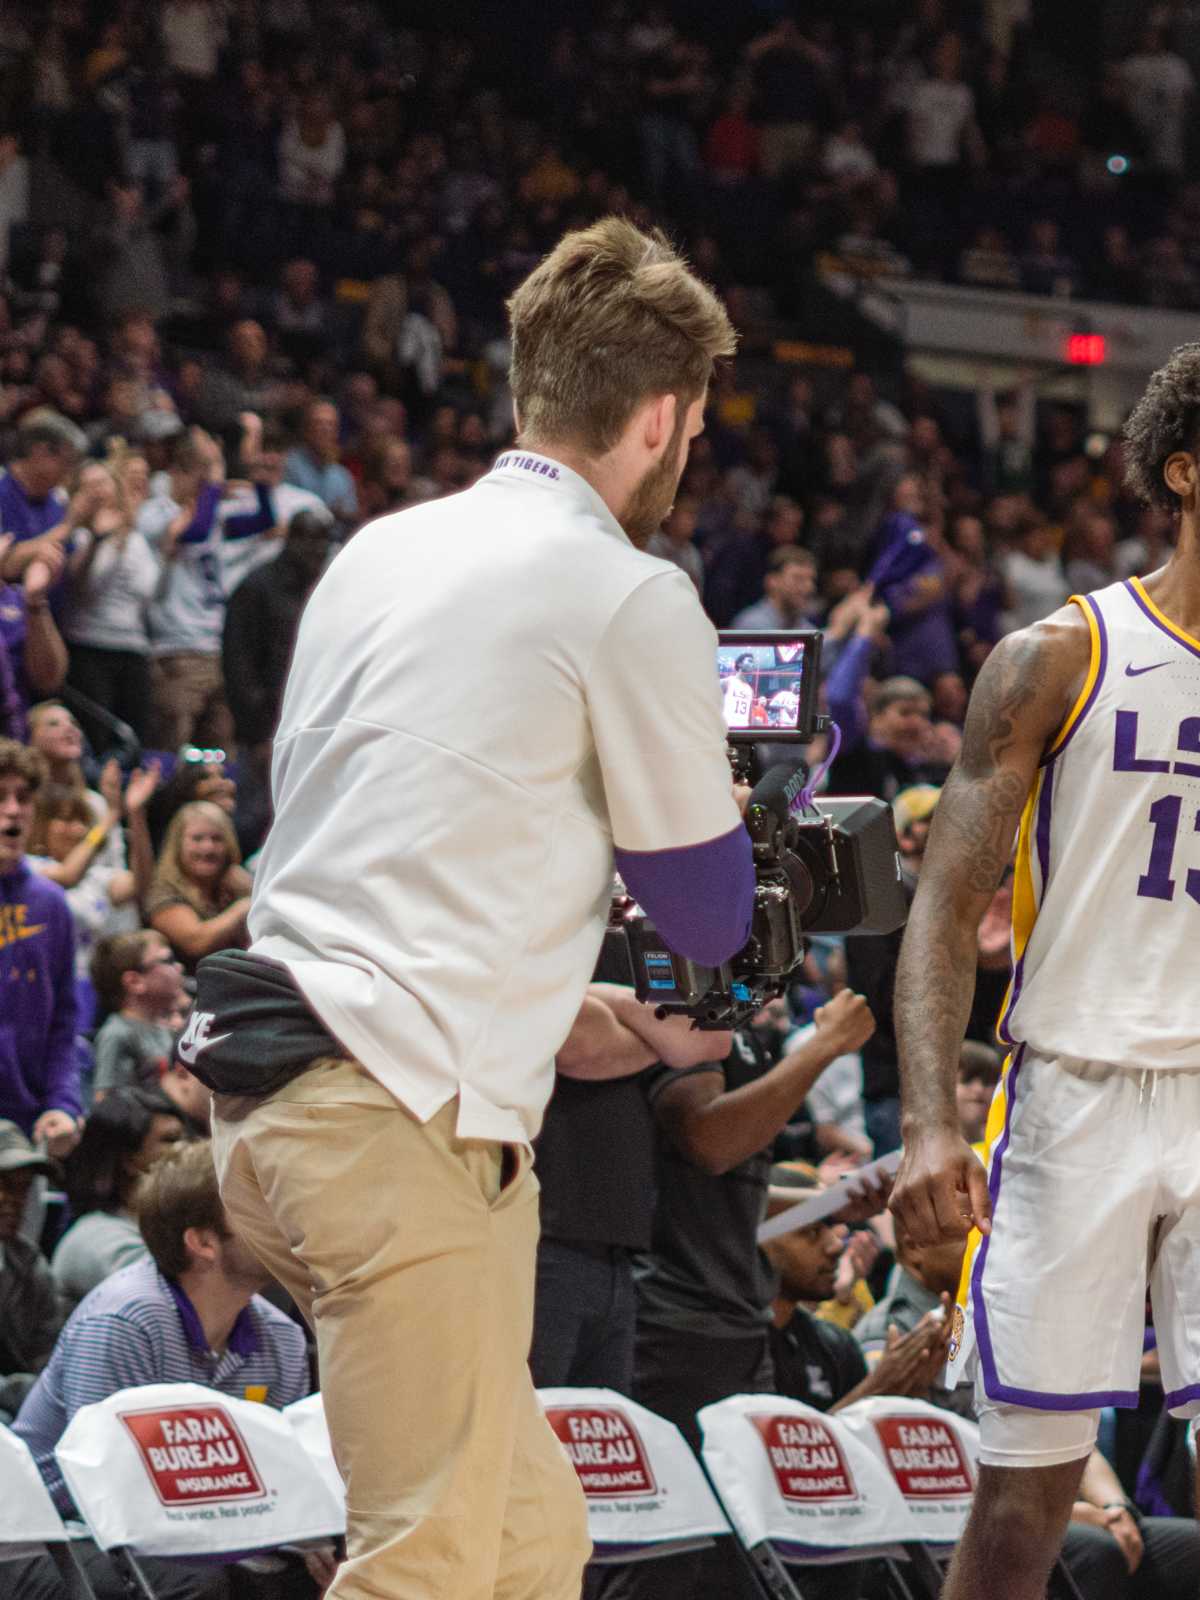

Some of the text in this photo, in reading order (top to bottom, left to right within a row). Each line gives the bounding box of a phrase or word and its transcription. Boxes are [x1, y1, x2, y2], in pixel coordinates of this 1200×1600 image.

[734, 700, 747, 715] 13
[159, 1415, 231, 1445] FARM
[567, 1416, 629, 1440] FARM
[777, 1422, 831, 1446] FARM
[898, 1425, 951, 1447] FARM
[147, 1439, 241, 1472] BUREAU
[564, 1438, 637, 1465] UREAU
[771, 1446, 839, 1470] BUREAU
[888, 1446, 961, 1470] BUREAU
[174, 1471, 252, 1494] INSURANCE
[579, 1470, 645, 1489] NSURANCE
